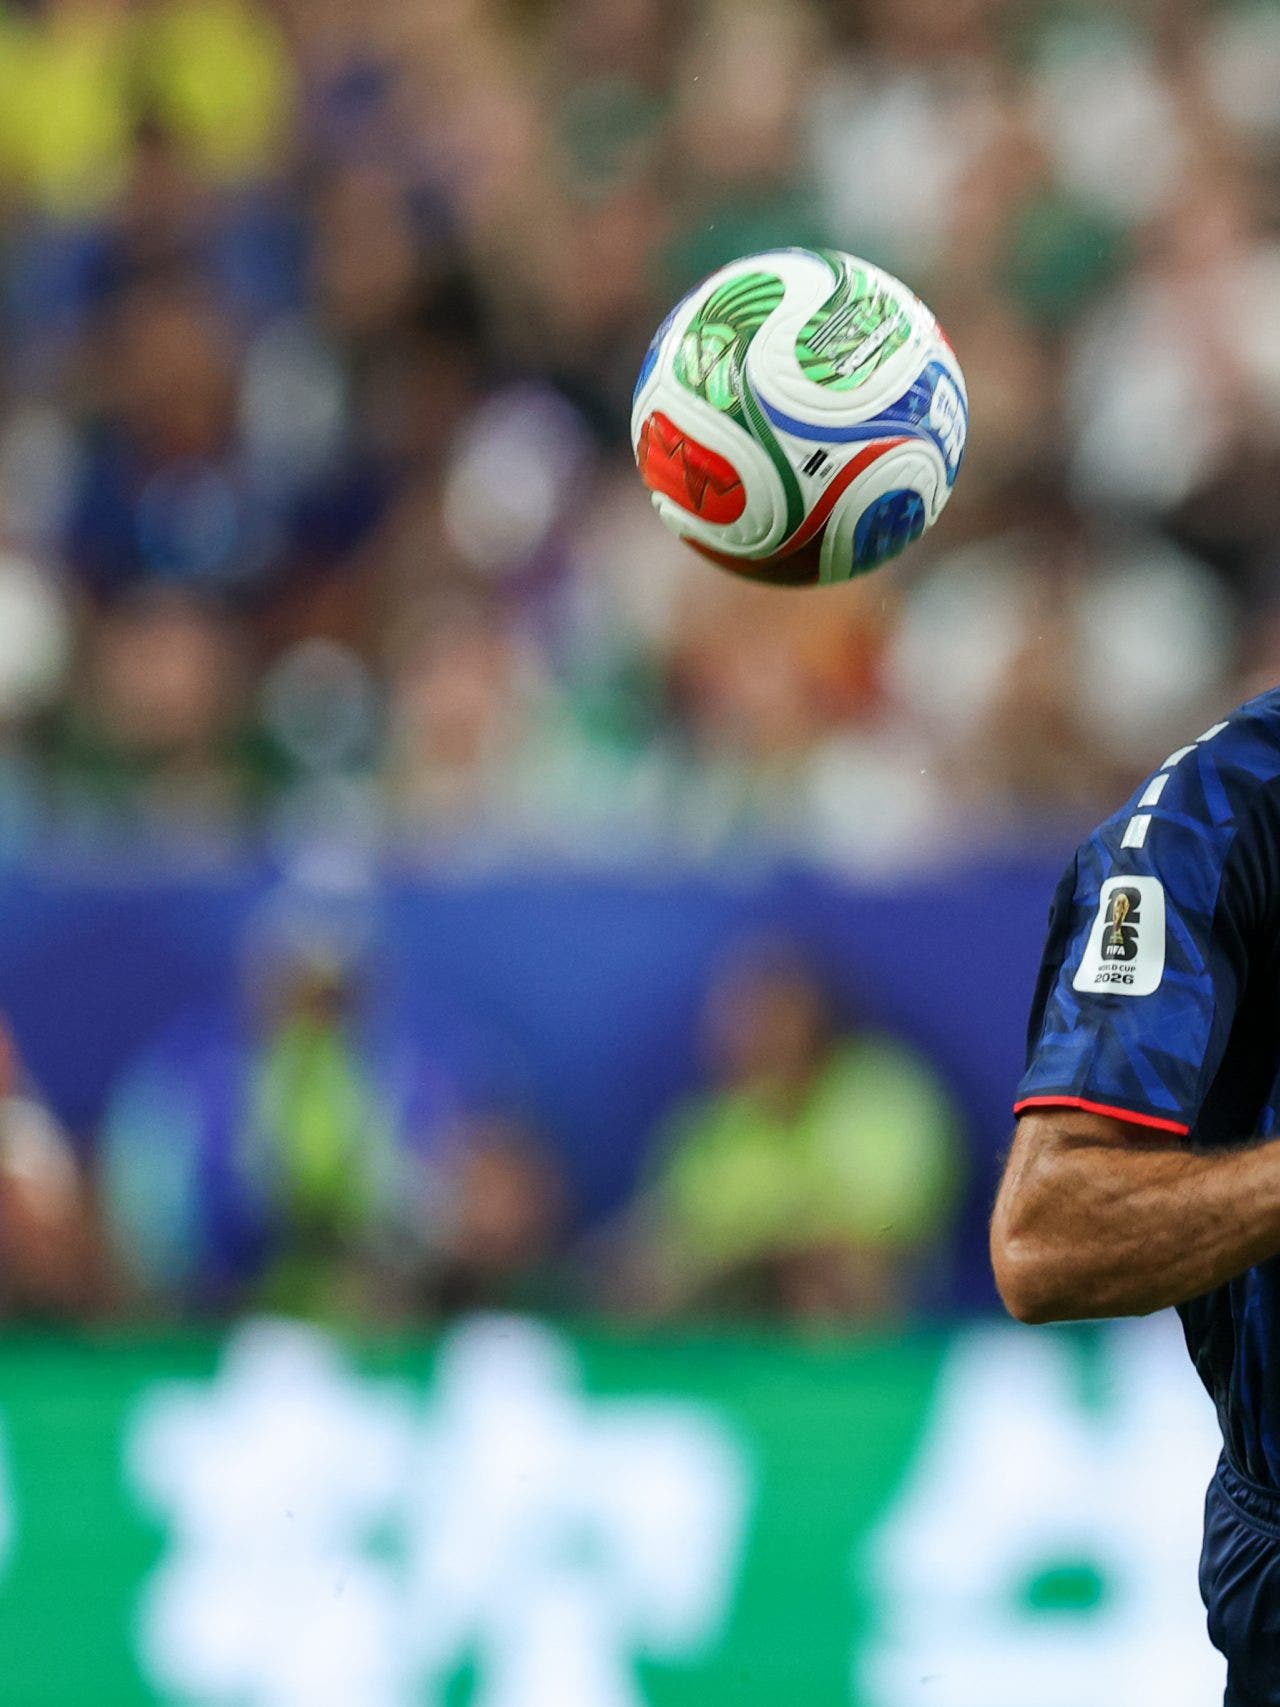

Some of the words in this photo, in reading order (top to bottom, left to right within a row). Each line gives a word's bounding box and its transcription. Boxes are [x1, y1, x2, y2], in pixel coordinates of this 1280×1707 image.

[1106, 944, 1126, 956] FIFA
[1119, 964, 1136, 973] CUP
[1094, 972, 1135, 985] 2026
